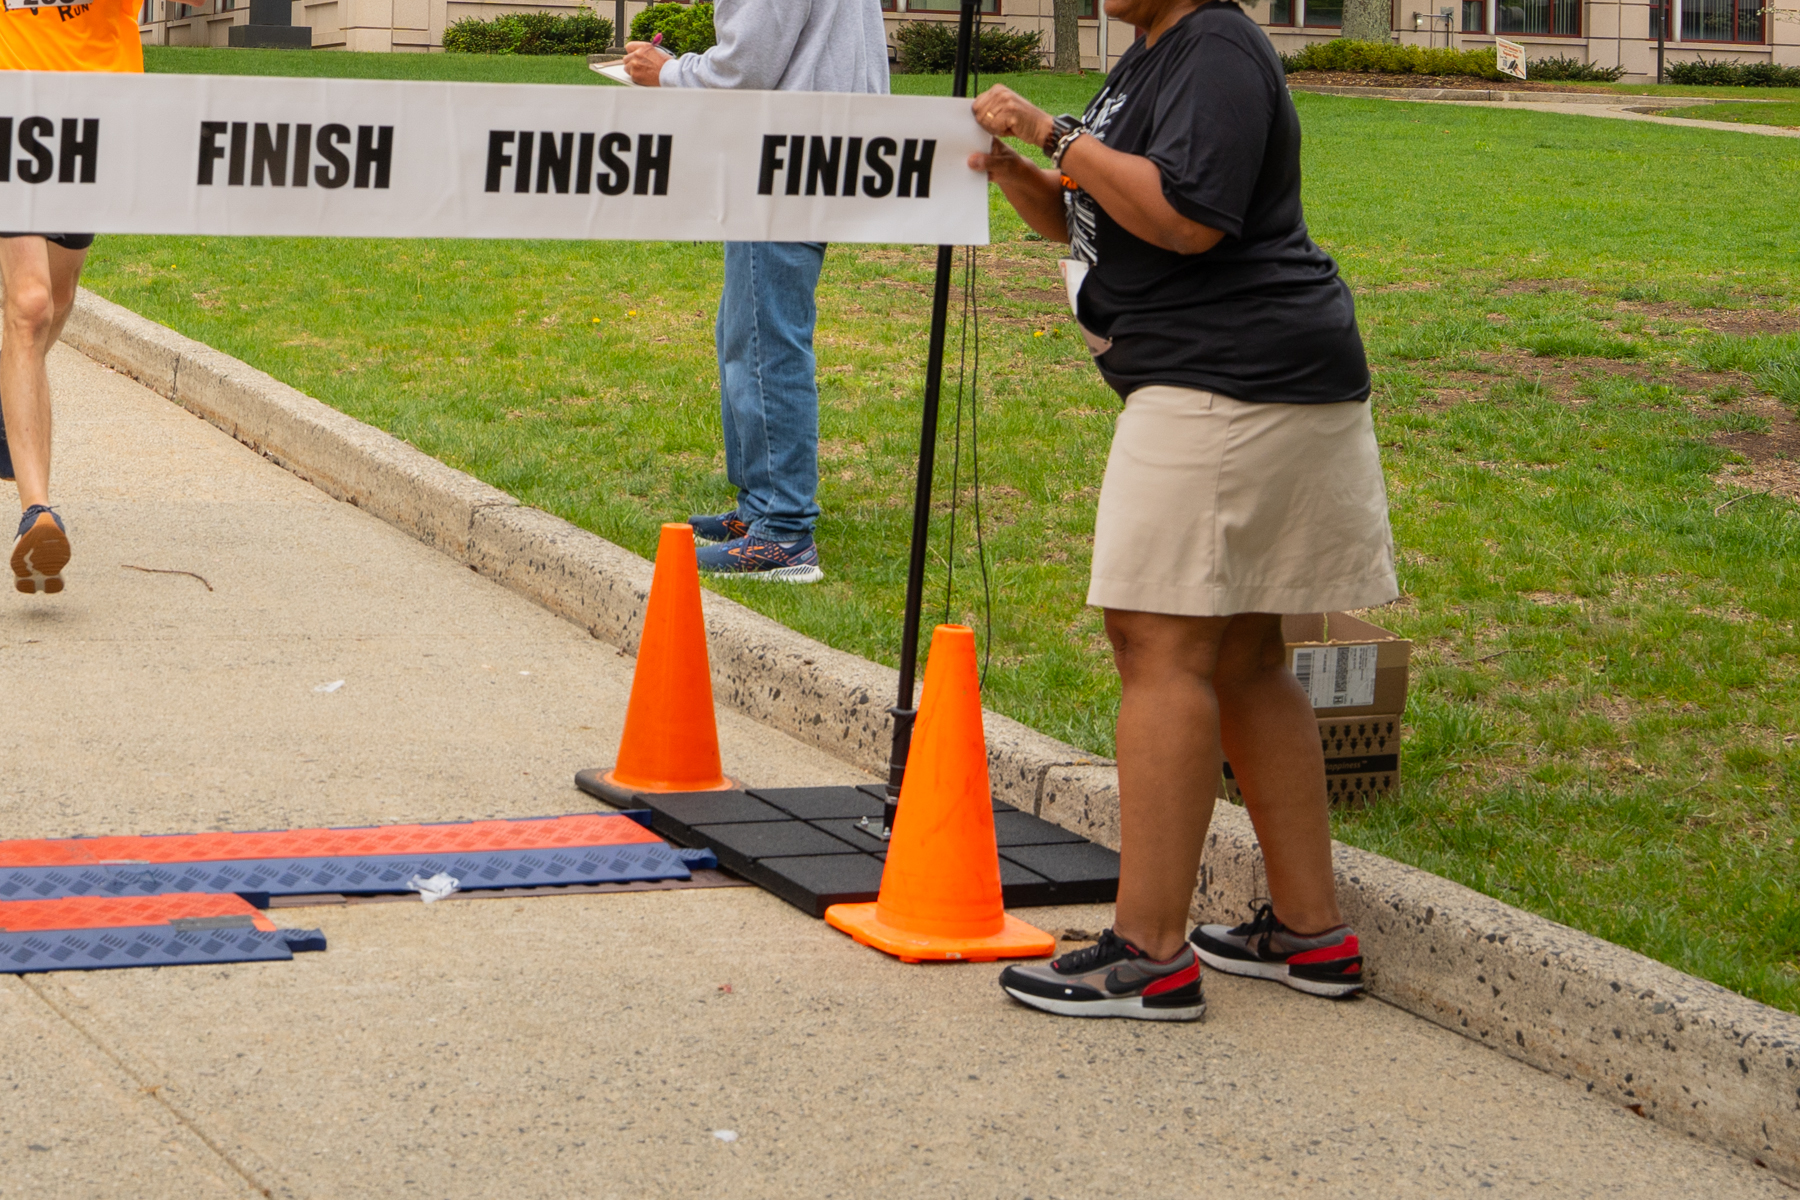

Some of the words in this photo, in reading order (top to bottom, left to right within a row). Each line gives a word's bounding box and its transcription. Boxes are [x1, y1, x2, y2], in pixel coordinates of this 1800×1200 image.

[196, 121, 394, 189] FINISH
[484, 130, 673, 195] FINISH
[757, 134, 937, 198] FINISH
